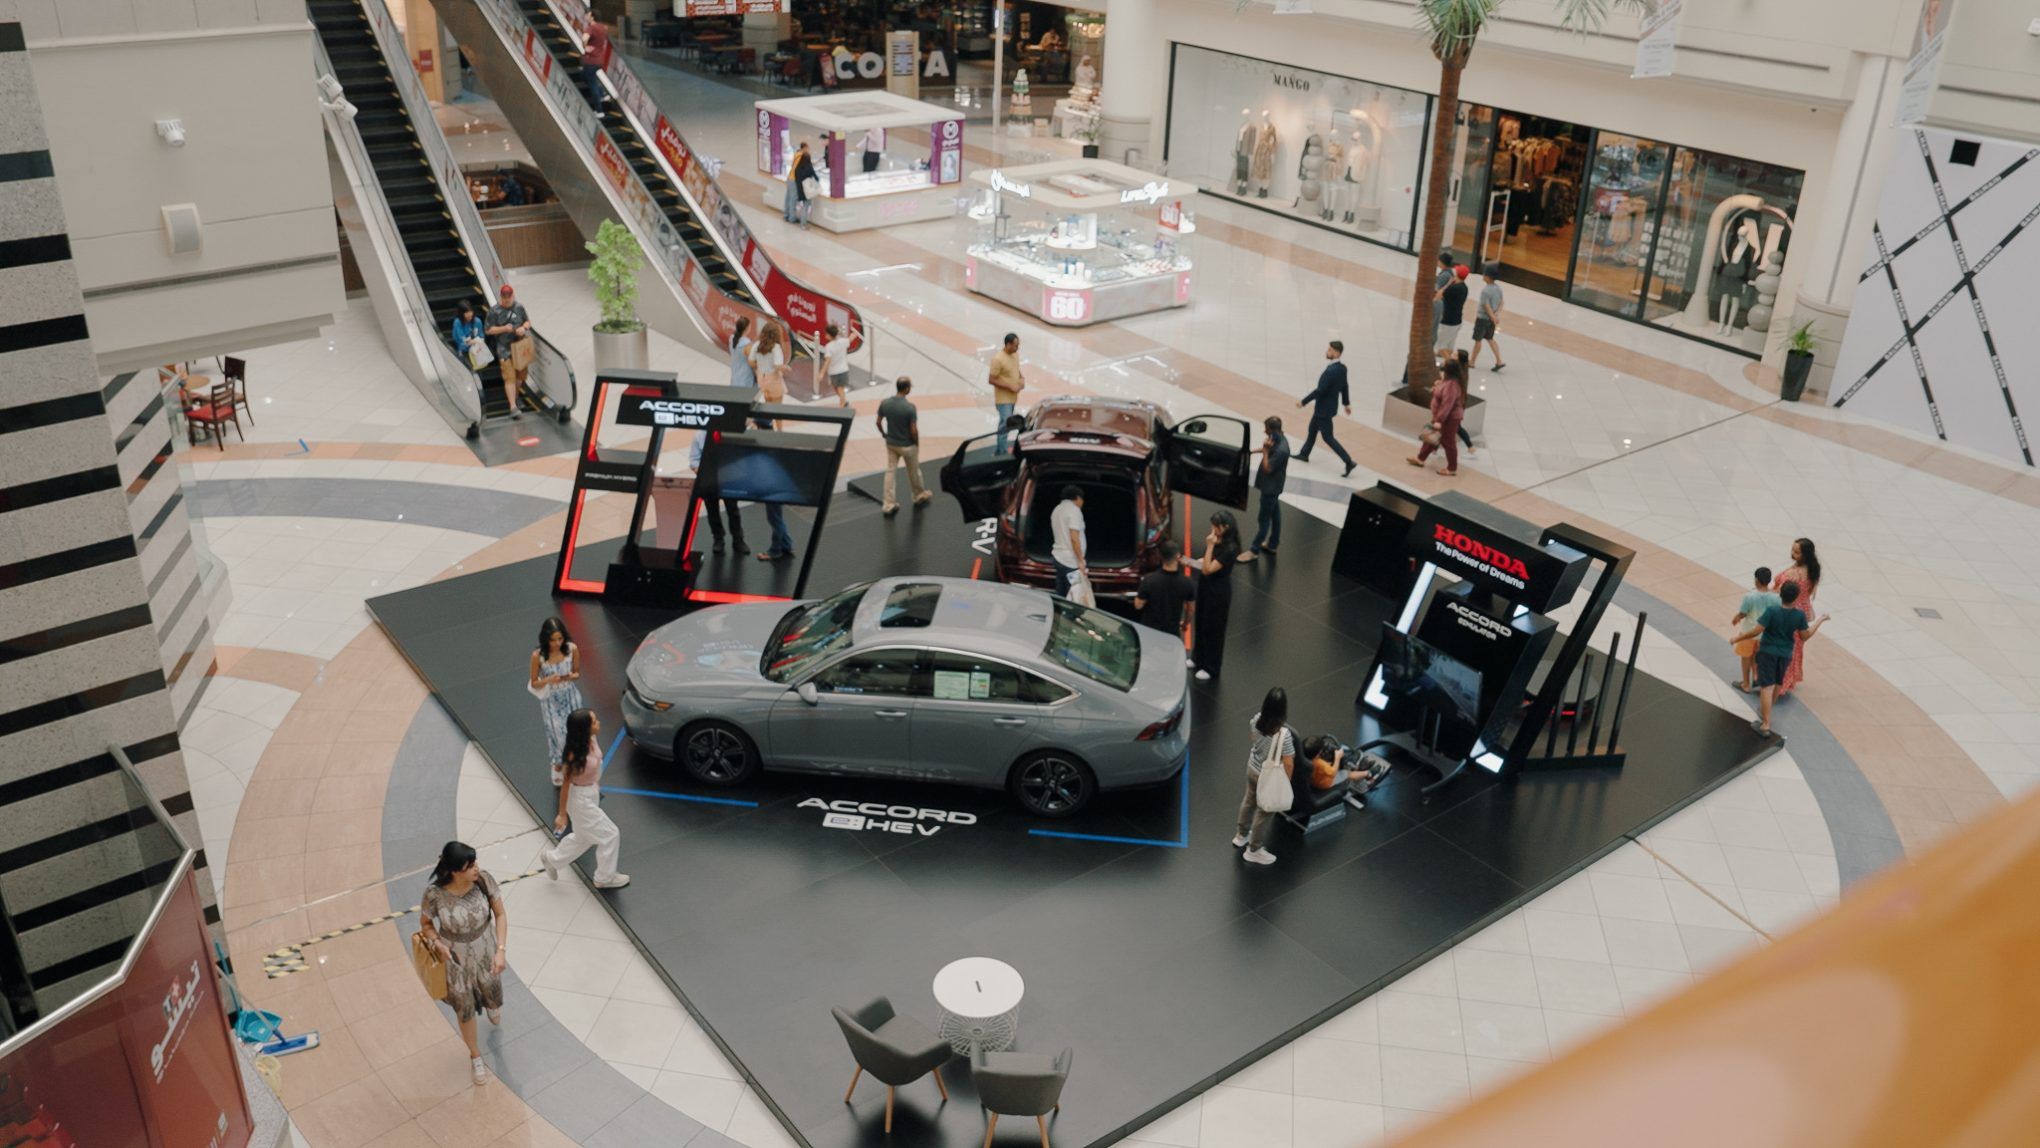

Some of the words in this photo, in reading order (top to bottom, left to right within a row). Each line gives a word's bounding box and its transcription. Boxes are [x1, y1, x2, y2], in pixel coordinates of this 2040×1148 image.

[834, 50, 950, 79] COA
[1272, 72, 1310, 91] MANGO
[639, 400, 725, 416] ACCORD
[1433, 523, 1530, 580] HONDA
[1435, 541, 1452, 556] The
[1451, 548, 1478, 568] Power
[1479, 562, 1490, 573] of
[1489, 567, 1525, 590] Dreams
[1446, 602, 1512, 637] ACCORD
[797, 797, 978, 825] ACCORD
